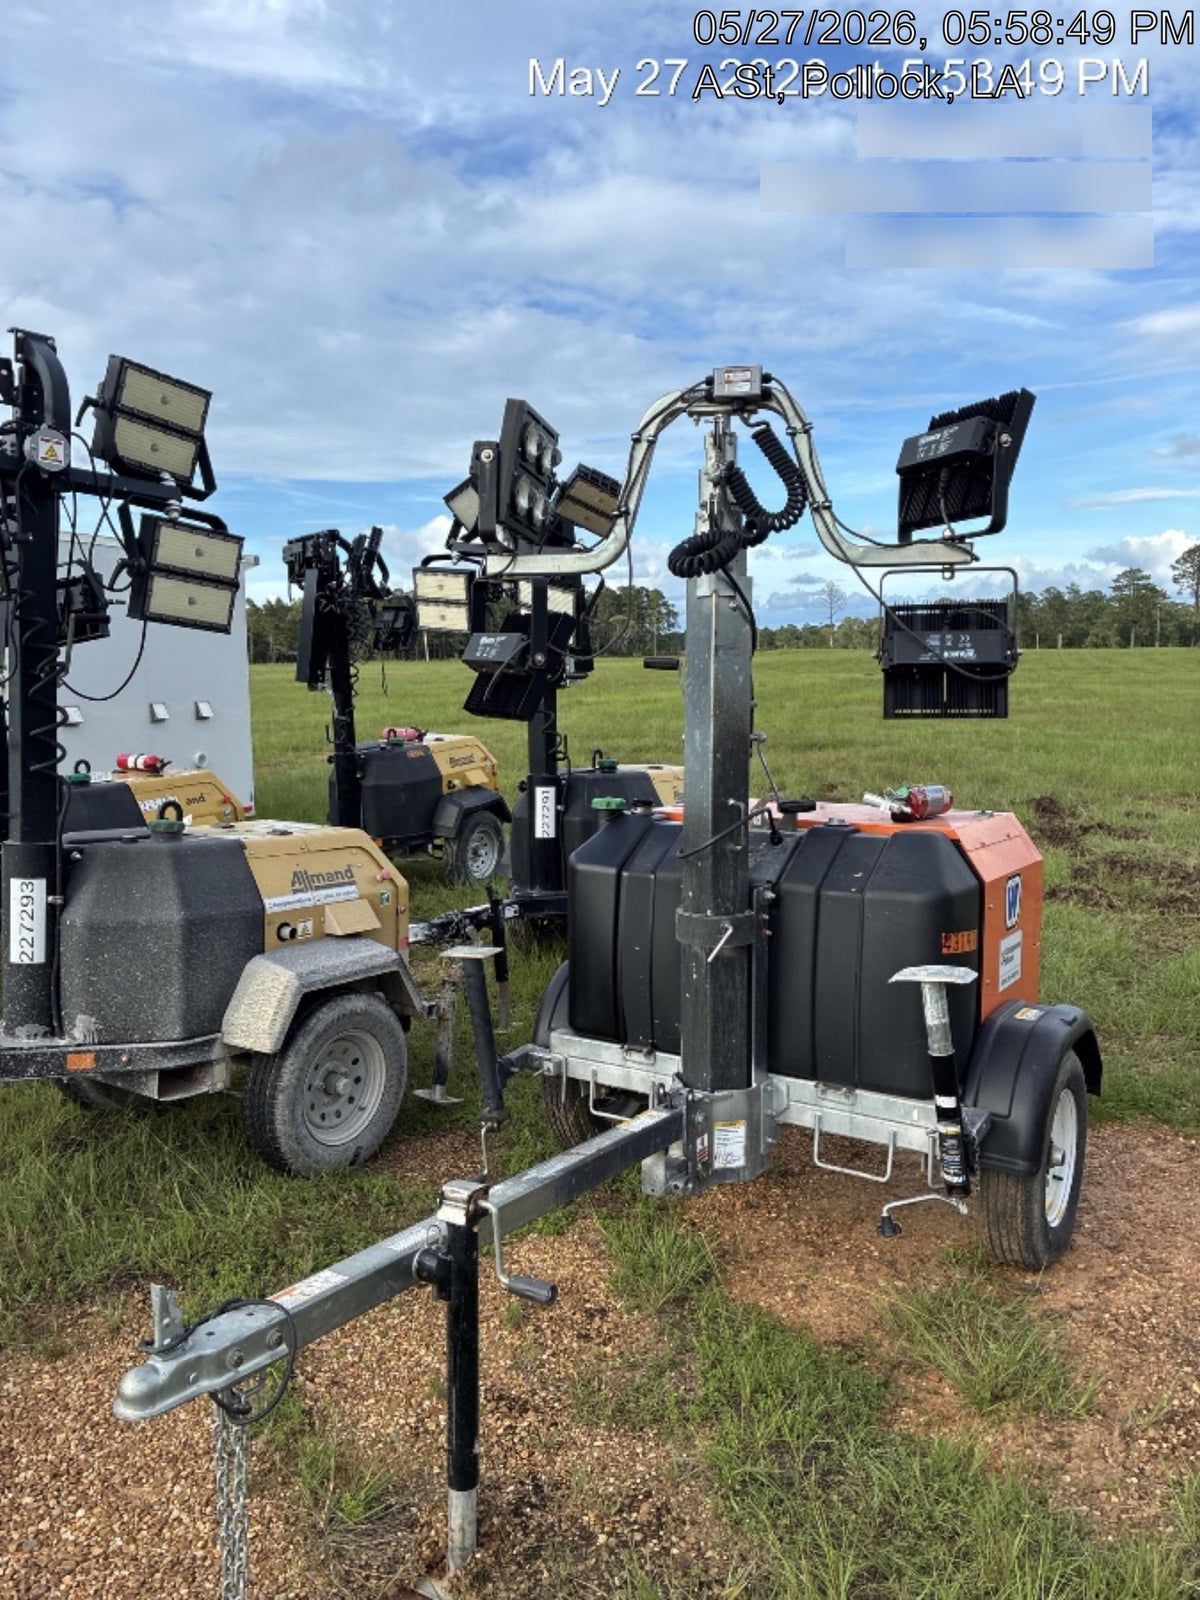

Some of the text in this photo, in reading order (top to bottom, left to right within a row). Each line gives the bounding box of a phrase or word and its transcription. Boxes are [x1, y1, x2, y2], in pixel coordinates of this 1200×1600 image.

[541, 789, 551, 838] 227291
[290, 864, 356, 893] Allmand
[18, 880, 35, 963] 227293
